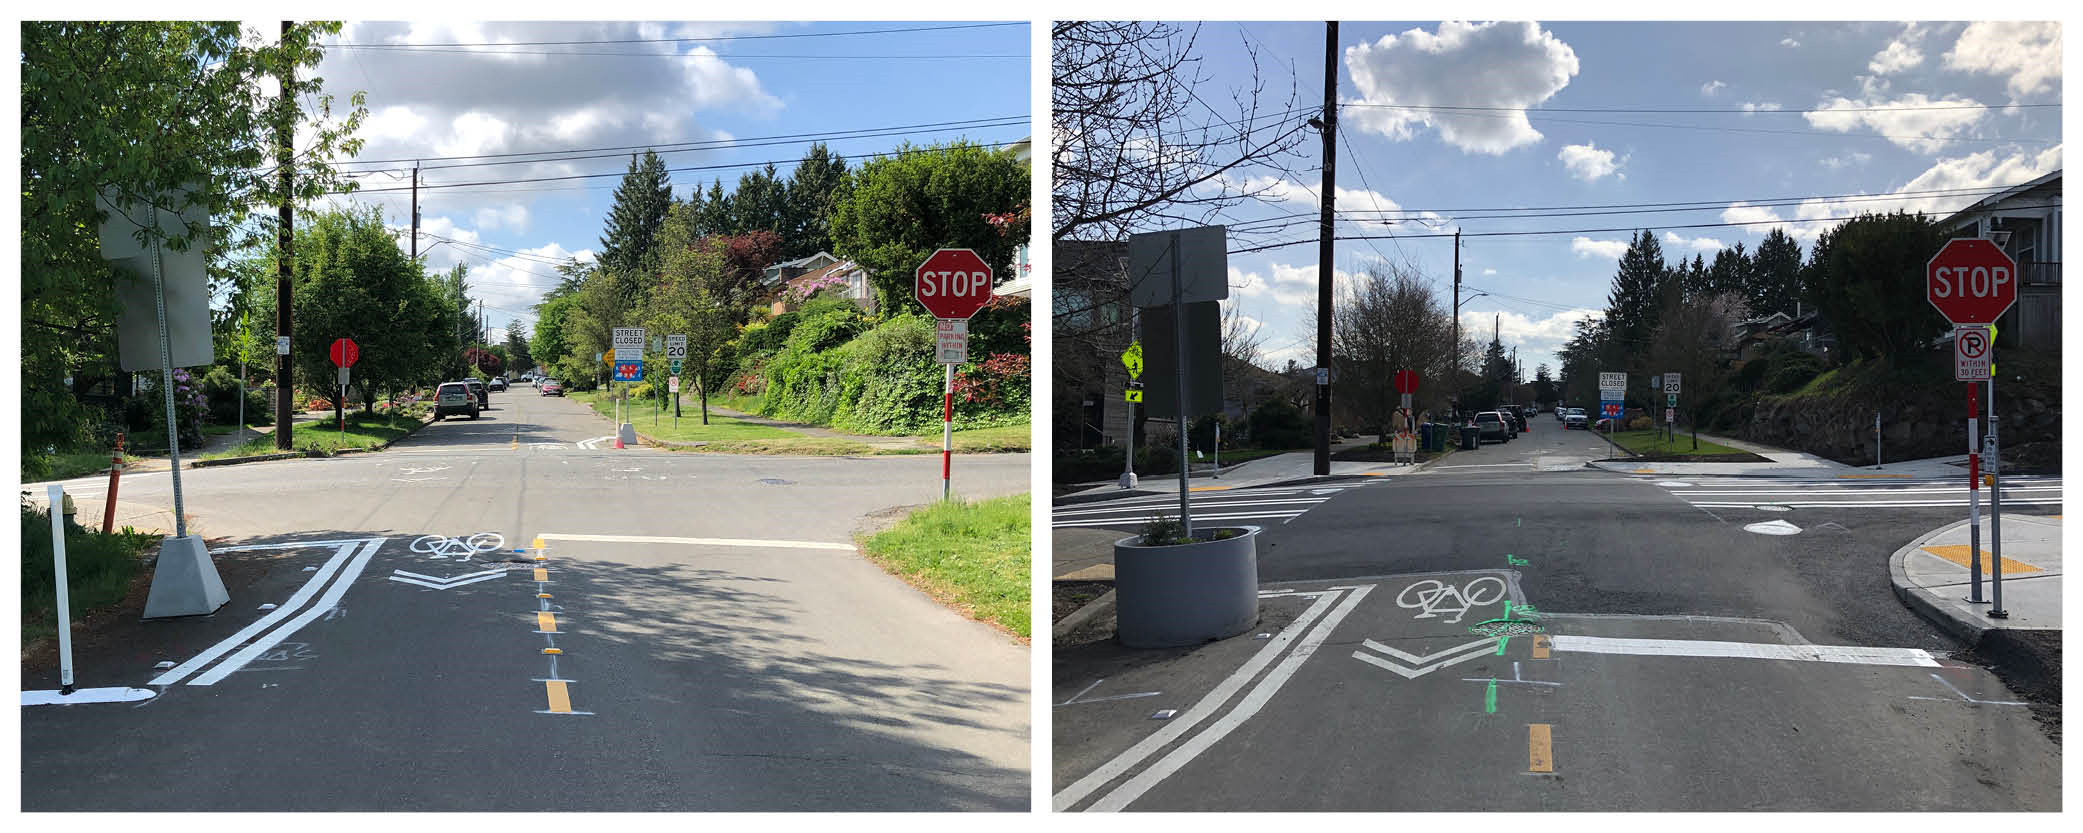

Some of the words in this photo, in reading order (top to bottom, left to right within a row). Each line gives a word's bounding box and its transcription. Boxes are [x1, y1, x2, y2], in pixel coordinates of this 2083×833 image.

[921, 271, 987, 297] STOP
[1934, 266, 2009, 298] STOP
[615, 329, 643, 337] STREET
[668, 347, 685, 356] 20
[1960, 368, 1969, 376] 30
[1971, 368, 1987, 376] FEET
[1666, 383, 1680, 392] 20
